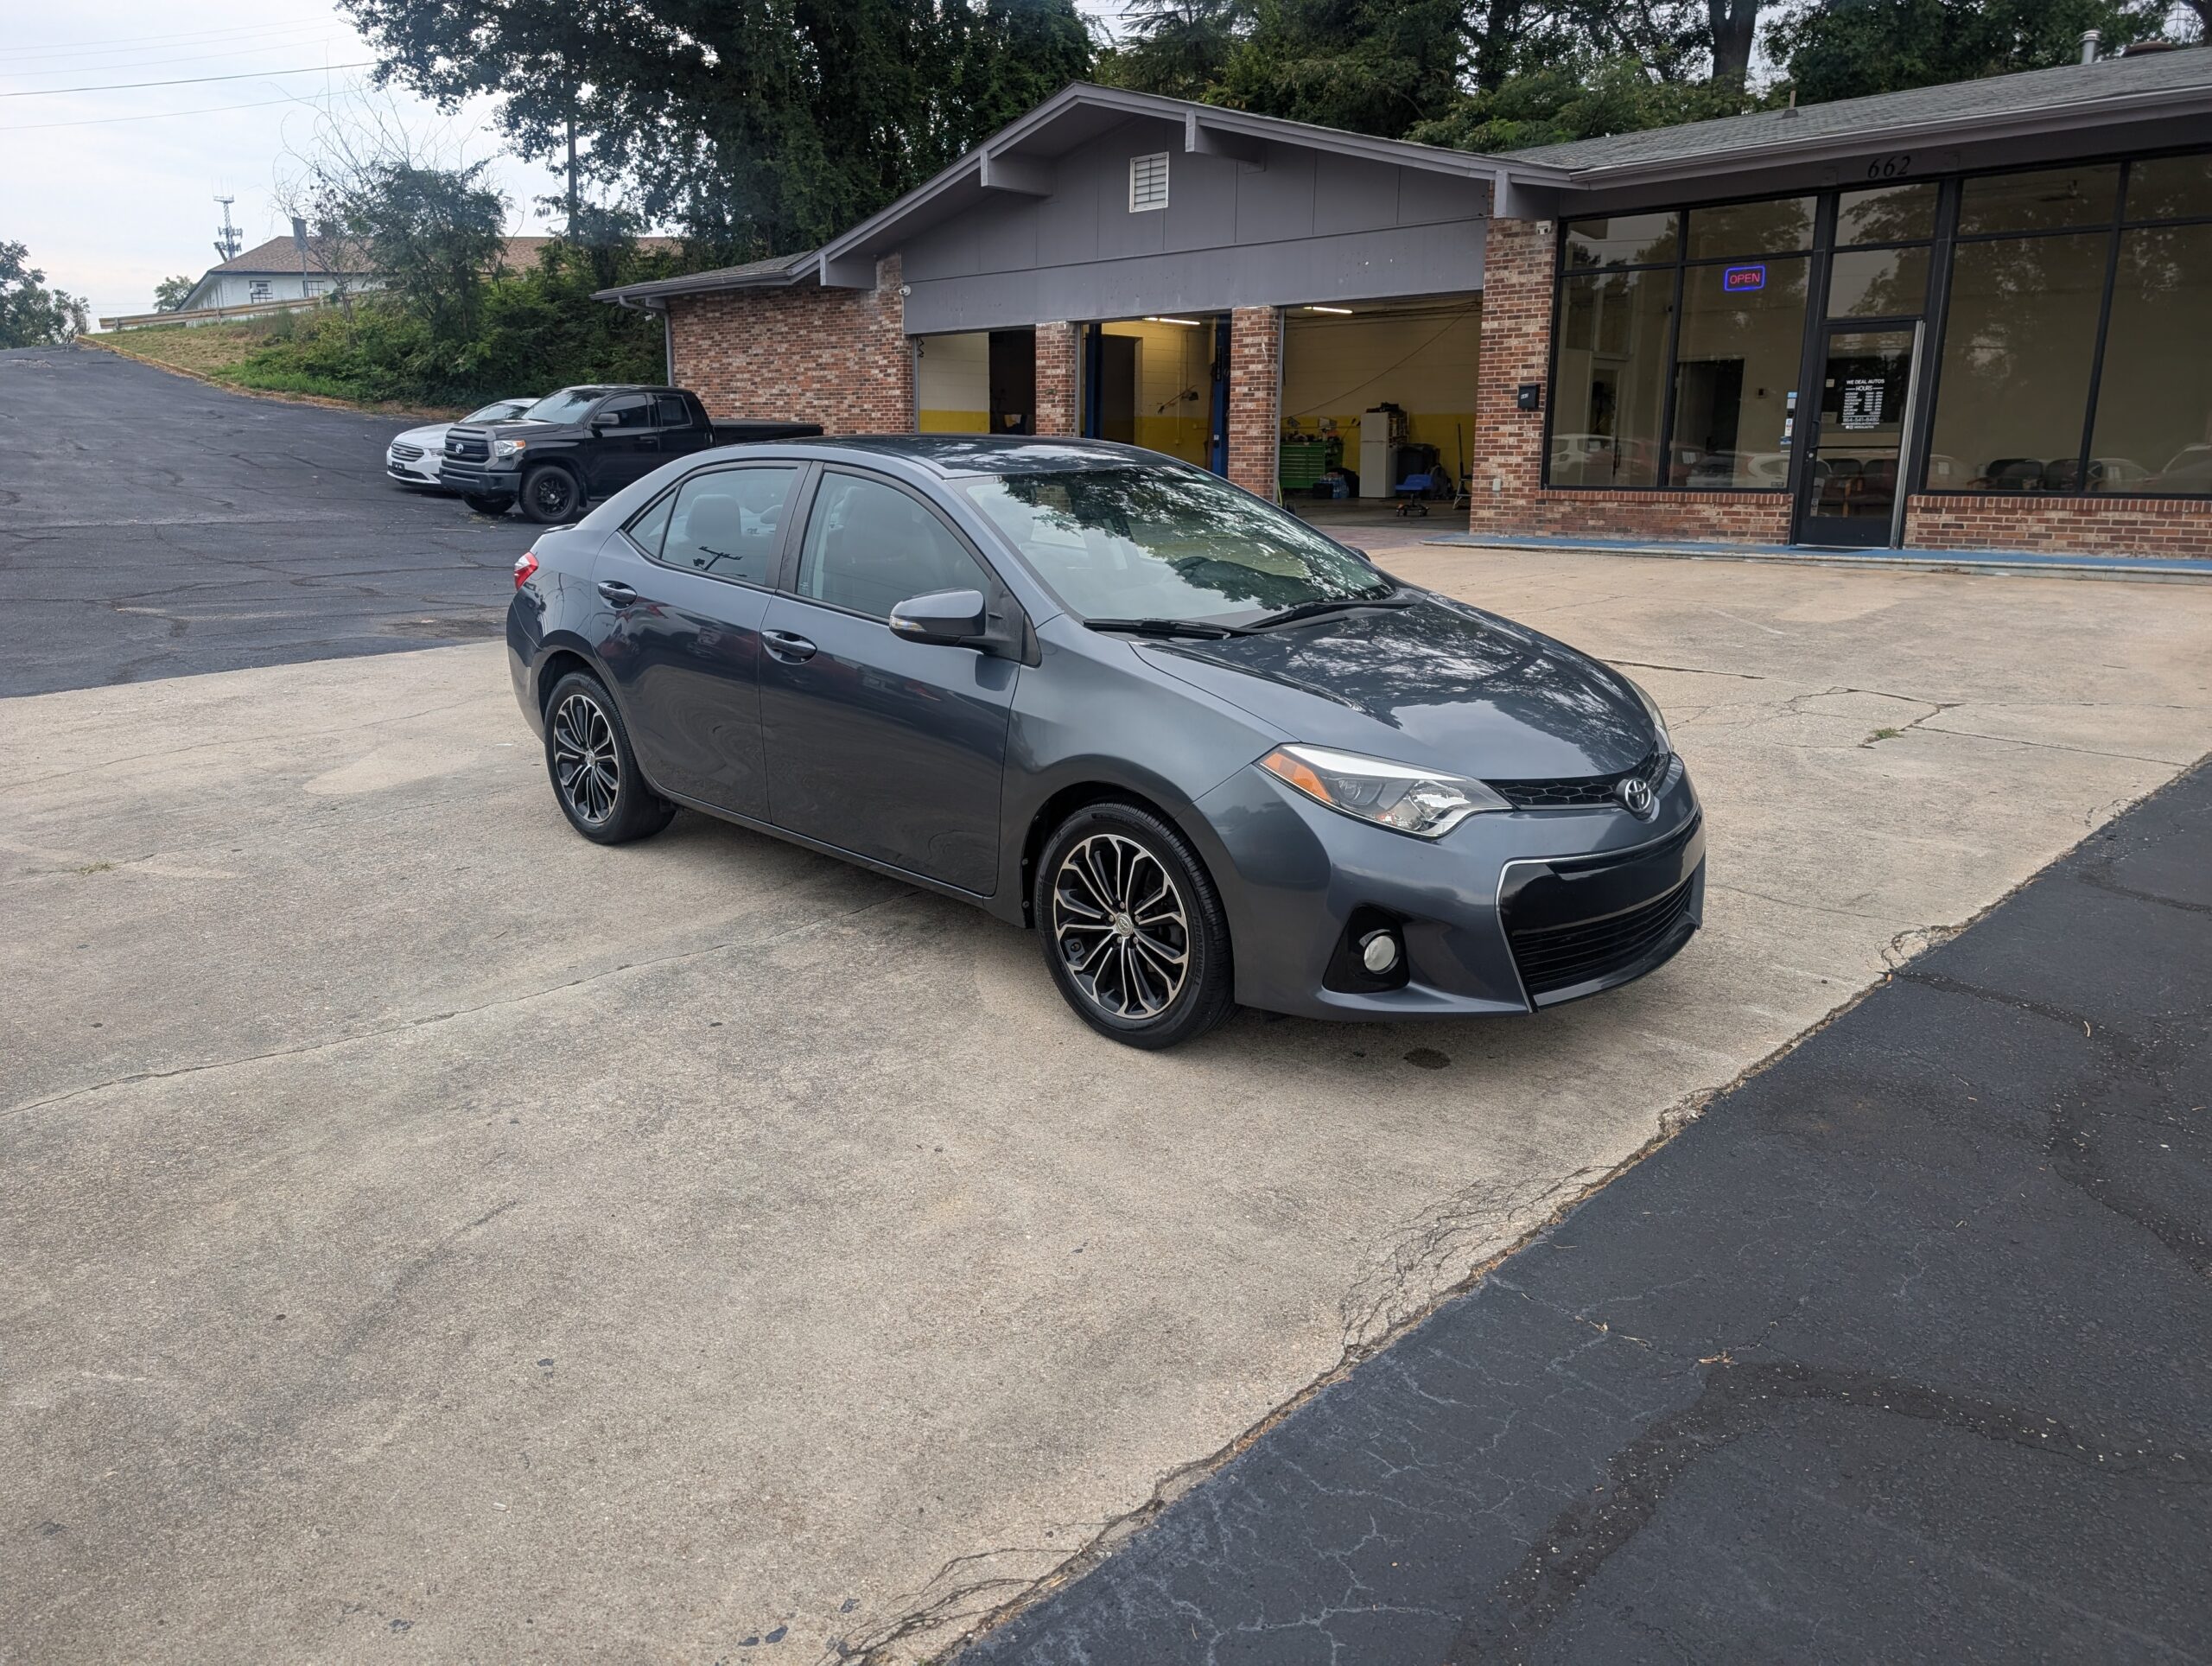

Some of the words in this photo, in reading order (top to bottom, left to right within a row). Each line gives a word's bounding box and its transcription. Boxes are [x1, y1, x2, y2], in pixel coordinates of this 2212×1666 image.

[1867, 156, 1911, 179] 662
[1729, 272, 1760, 284] OPEN
[1193, 916, 1205, 987] PRIMEWELL
